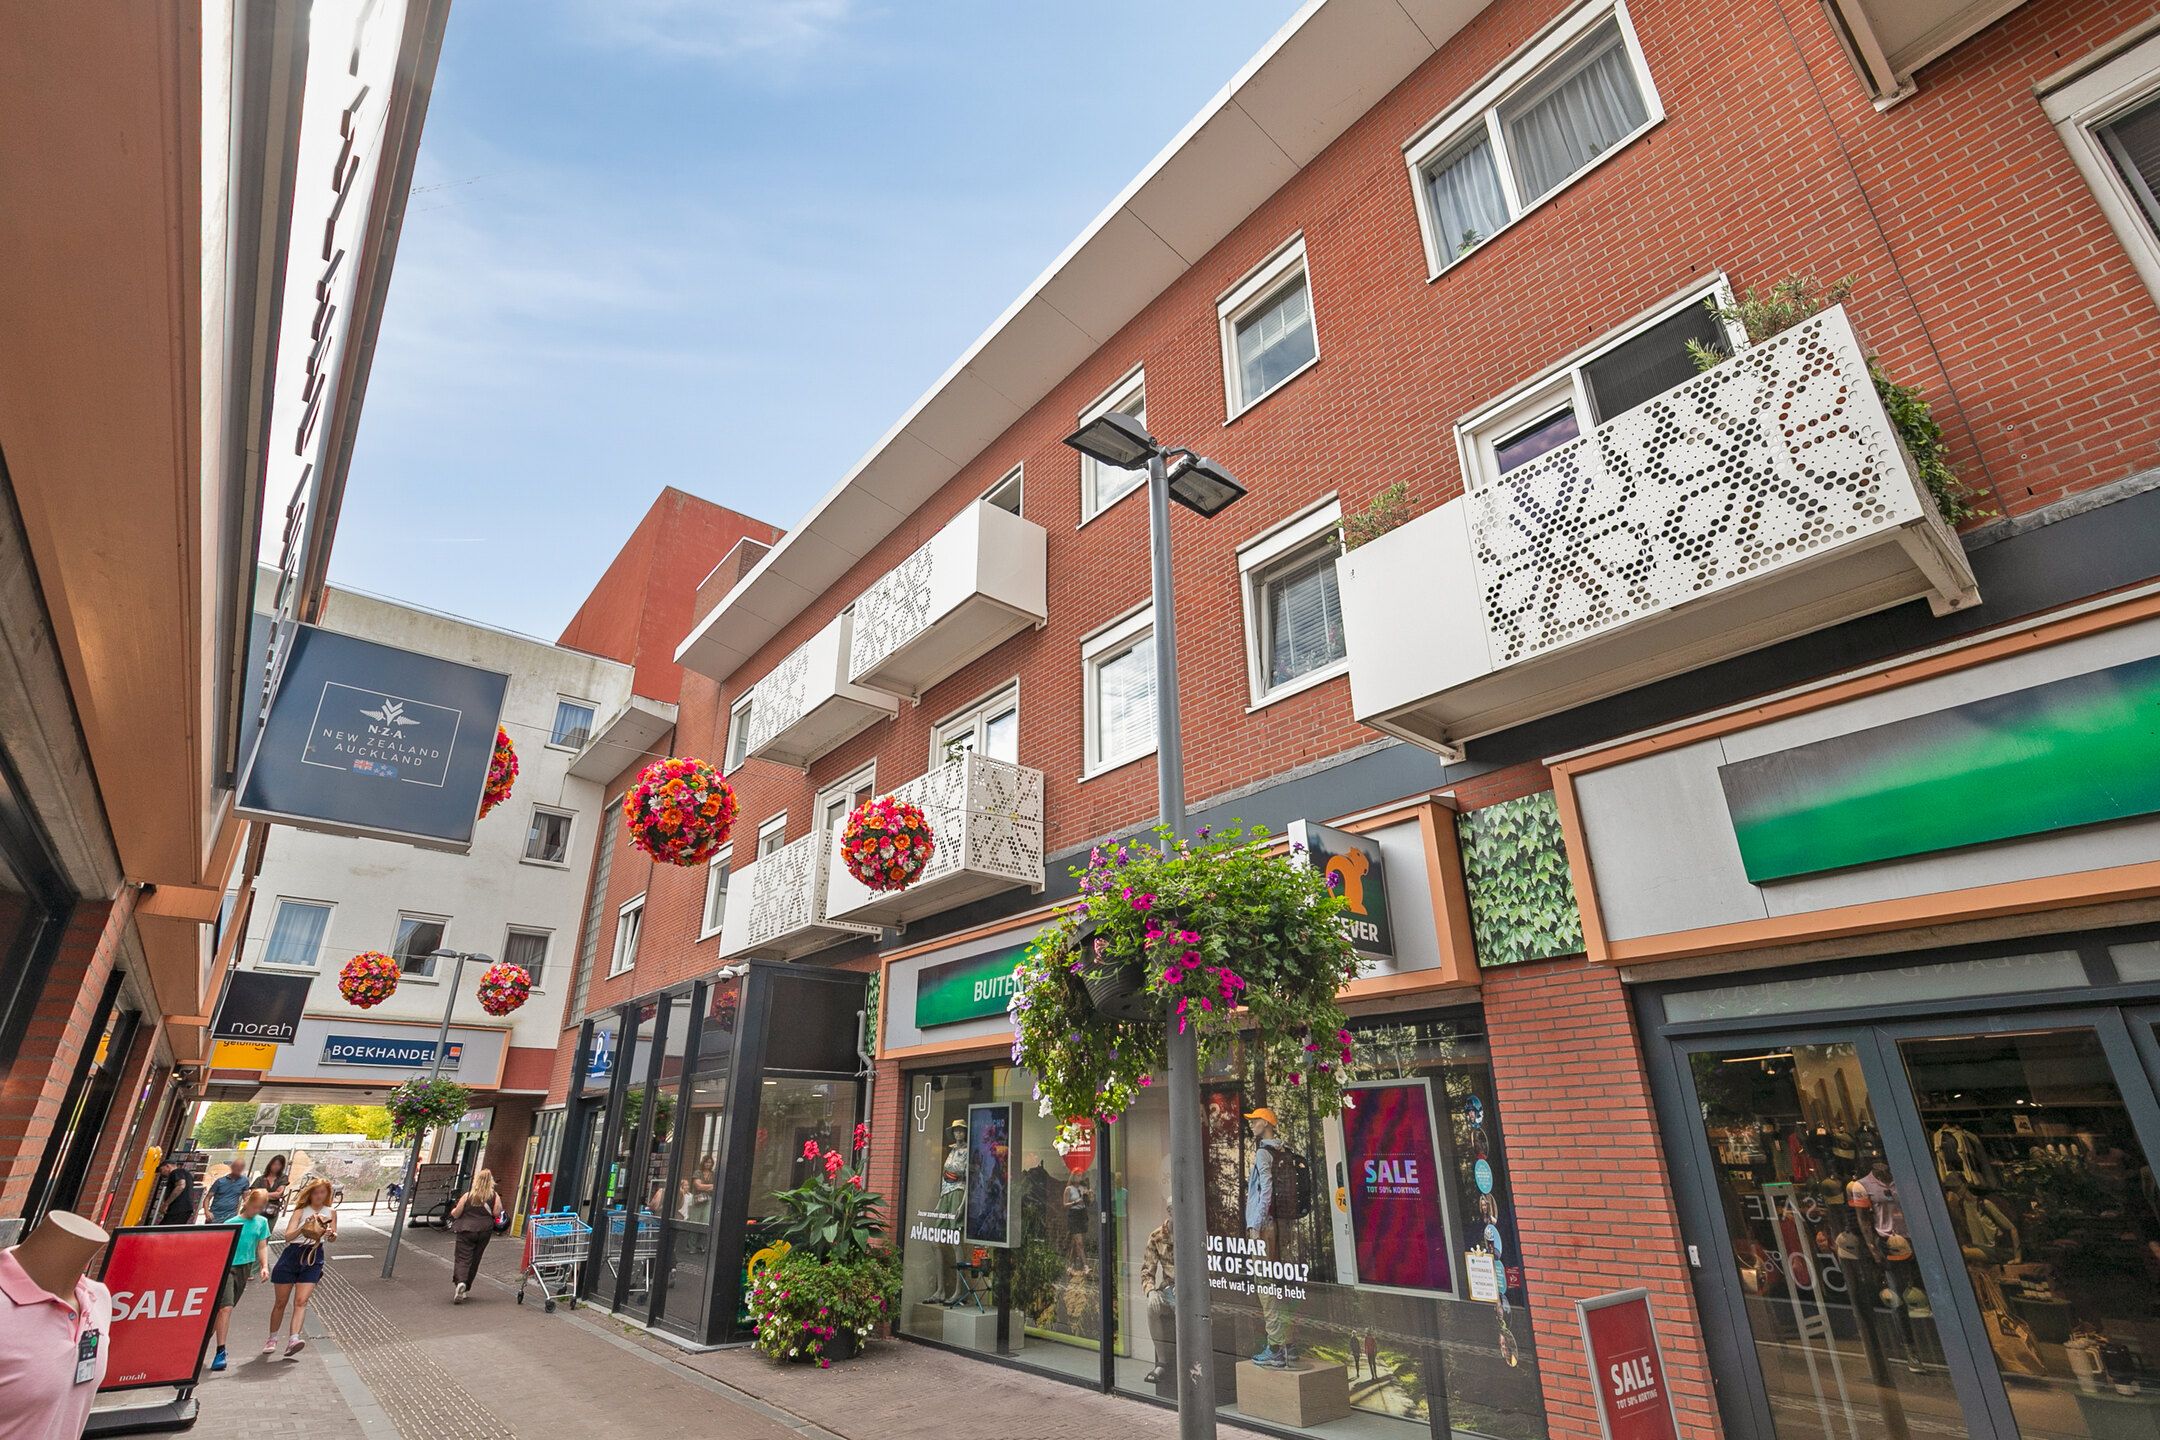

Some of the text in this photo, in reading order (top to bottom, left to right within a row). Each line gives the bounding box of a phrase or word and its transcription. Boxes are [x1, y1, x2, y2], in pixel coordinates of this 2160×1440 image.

[323, 729, 440, 759] NEW ZEALAND
[335, 743, 423, 766] AUCKLAND
[1340, 917, 1380, 943] EVER
[231, 1022, 293, 1036] norah
[331, 1044, 437, 1061] BOEKHANDEL
[1364, 1159, 1419, 1184] SALE
[1379, 1186, 1393, 1194] 50%
[1393, 1186, 1420, 1195] KORTING
[910, 1221, 961, 1245] AYACUCHO
[1206, 1235, 1267, 1257] UG NAAR
[1207, 1254, 1309, 1283] RK OF SCHOOL?
[1229, 1281, 1245, 1291] wat
[1246, 1281, 1255, 1295] je
[1257, 1284, 1282, 1300] nodig
[1285, 1285, 1306, 1300] hebt
[111, 1287, 208, 1322] SALE
[1610, 1355, 1655, 1396] SALE
